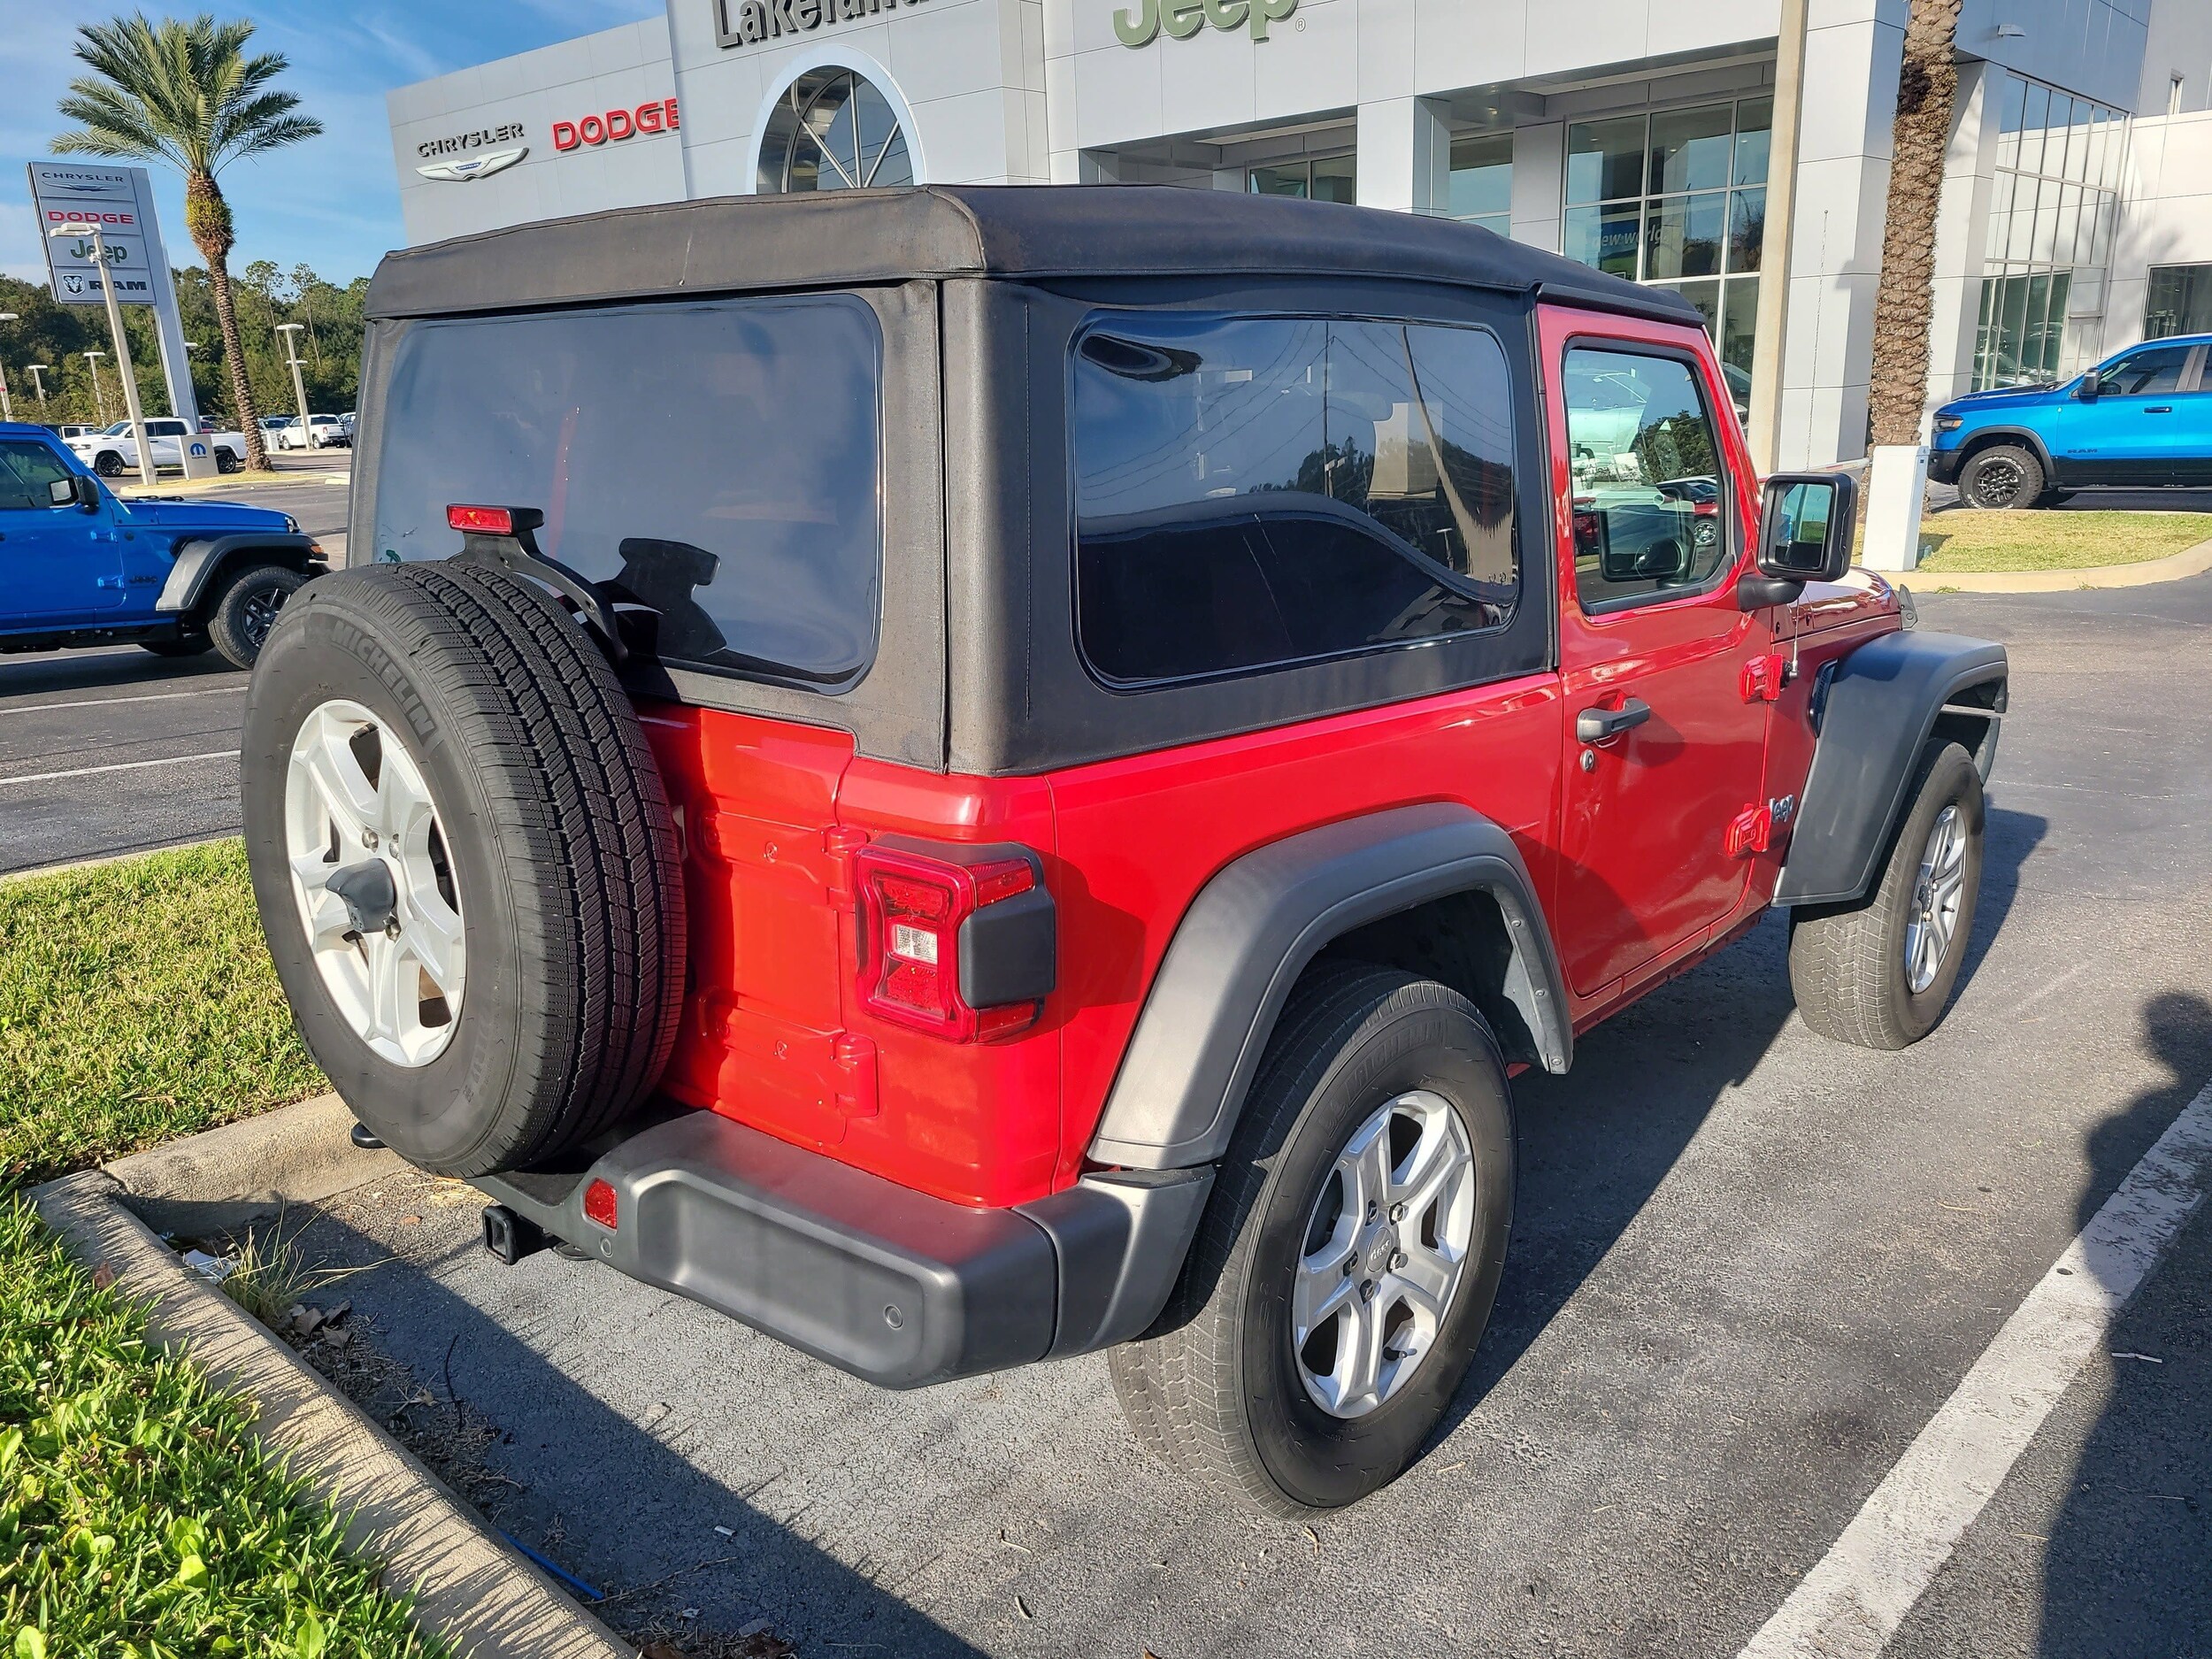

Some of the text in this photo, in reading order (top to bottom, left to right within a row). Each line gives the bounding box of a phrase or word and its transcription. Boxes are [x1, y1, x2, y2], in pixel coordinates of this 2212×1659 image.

[712, 0, 933, 49] Lake
[1113, 0, 1298, 48] Jeep
[417, 122, 524, 157] CHRYSLER
[552, 98, 680, 152] DODGE
[42, 172, 124, 182] CHRYSLER
[48, 211, 134, 225] DODGE
[88, 280, 148, 290] RAM
[331, 619, 438, 748] MICHELIN
